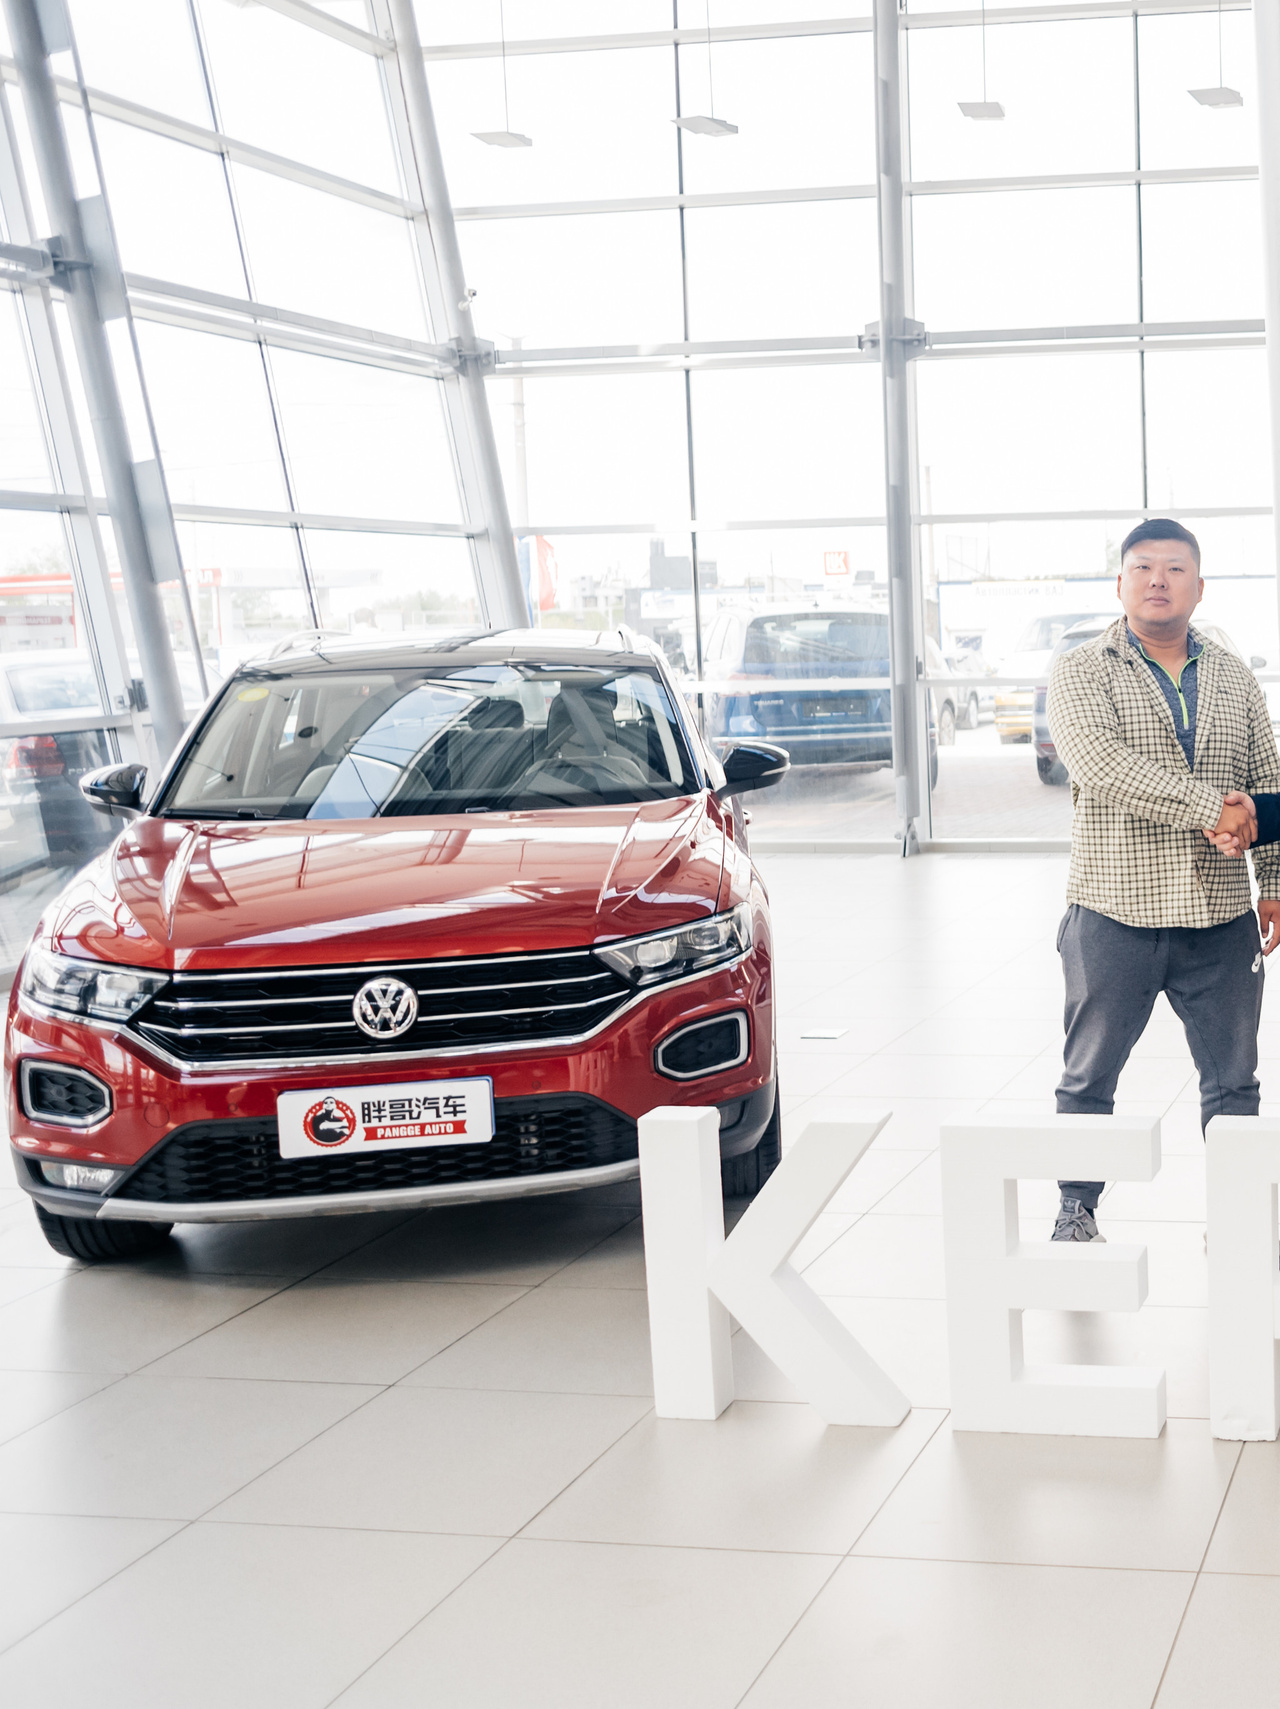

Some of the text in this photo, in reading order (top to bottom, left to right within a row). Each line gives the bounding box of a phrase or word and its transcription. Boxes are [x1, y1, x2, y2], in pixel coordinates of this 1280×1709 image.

[361, 1095, 467, 1124] 胖哥汽车
[377, 1122, 454, 1138] PANGGE AUTO
